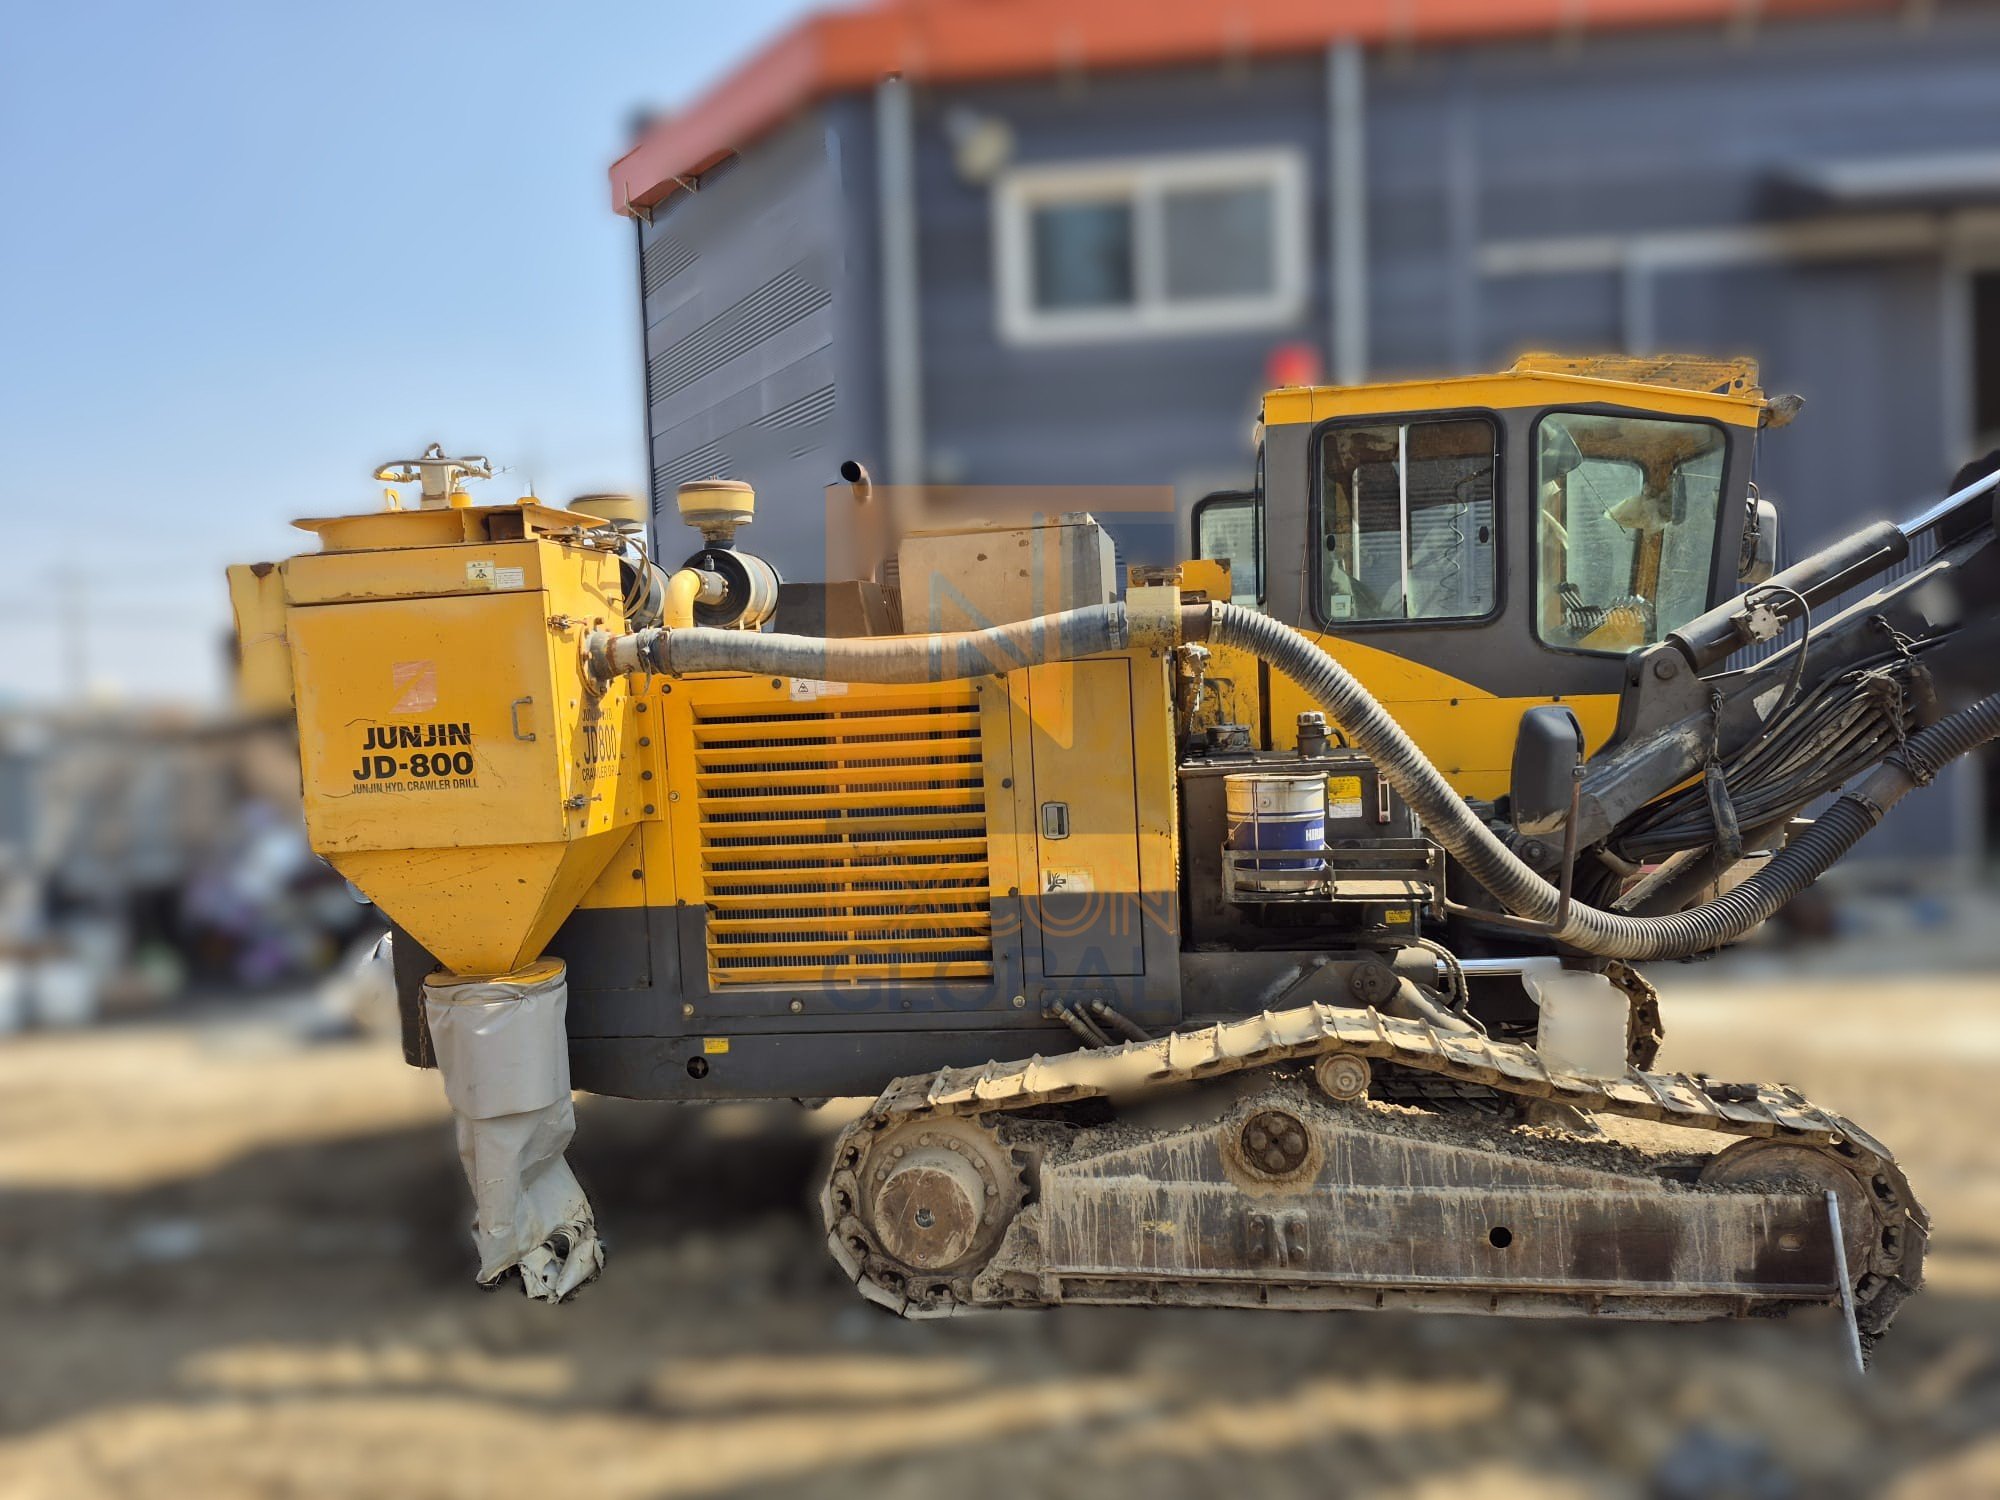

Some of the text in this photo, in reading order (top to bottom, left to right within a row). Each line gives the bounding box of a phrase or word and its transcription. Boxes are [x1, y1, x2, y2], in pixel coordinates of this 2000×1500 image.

[363, 722, 472, 750] JUNJIN
[352, 751, 474, 780] JD-800
[352, 778, 479, 794] JUNJIN HYD. CRAWLER DRILL
